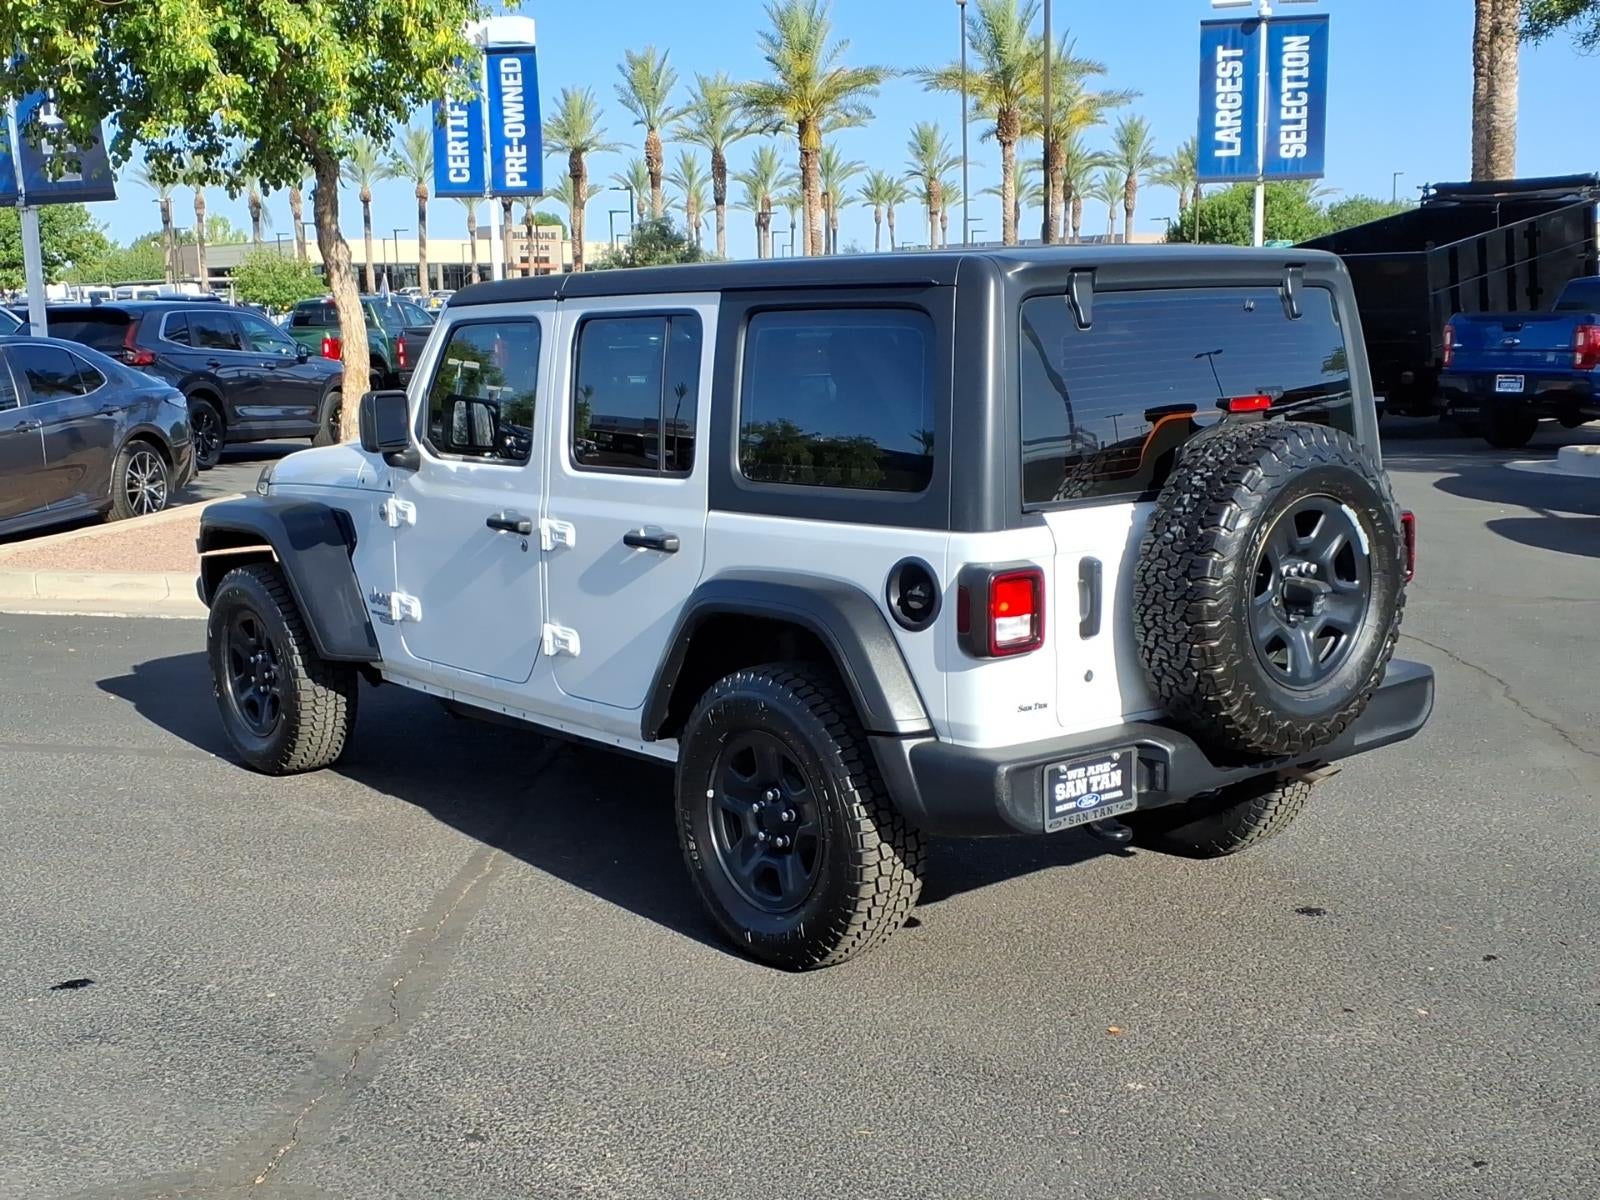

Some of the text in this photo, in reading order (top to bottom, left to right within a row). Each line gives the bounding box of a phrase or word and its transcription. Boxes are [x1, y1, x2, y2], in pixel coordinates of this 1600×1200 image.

[447, 85, 470, 183] CERTIF
[500, 57, 527, 187] PRE-OWNED
[1214, 45, 1243, 157] LARGEST
[1279, 35, 1310, 159] SELECTION
[1055, 777, 1088, 801] SAN
[1089, 769, 1122, 792] TAN
[1067, 762, 1111, 780] WE ARE
[1068, 805, 1113, 825] SAN TAN
